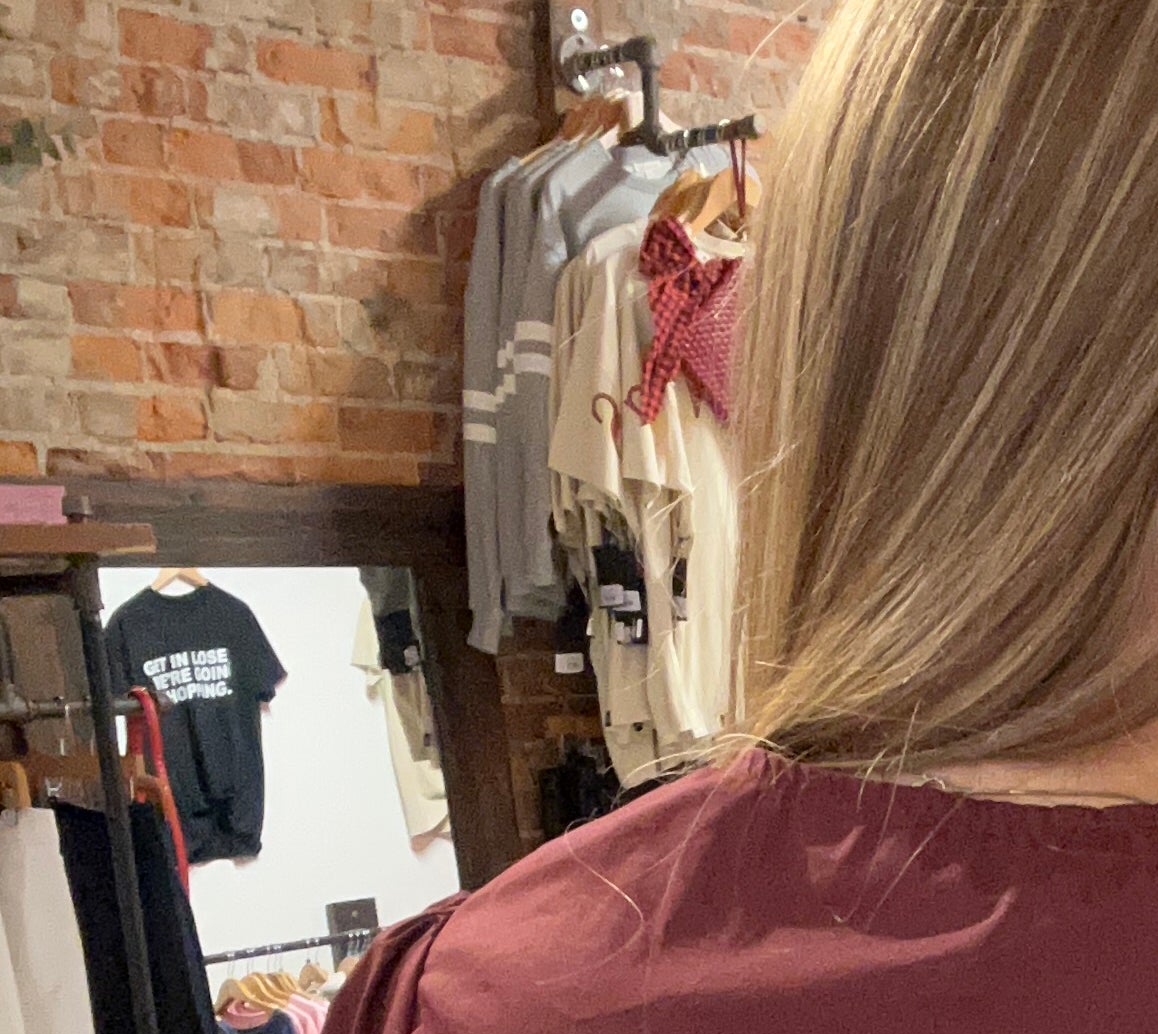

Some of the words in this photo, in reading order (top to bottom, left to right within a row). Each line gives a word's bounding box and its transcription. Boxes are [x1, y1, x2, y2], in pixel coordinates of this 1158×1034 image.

[143, 656, 167, 676] GET
[169, 651, 189, 669] IN
[194, 664, 232, 682] GOIN
